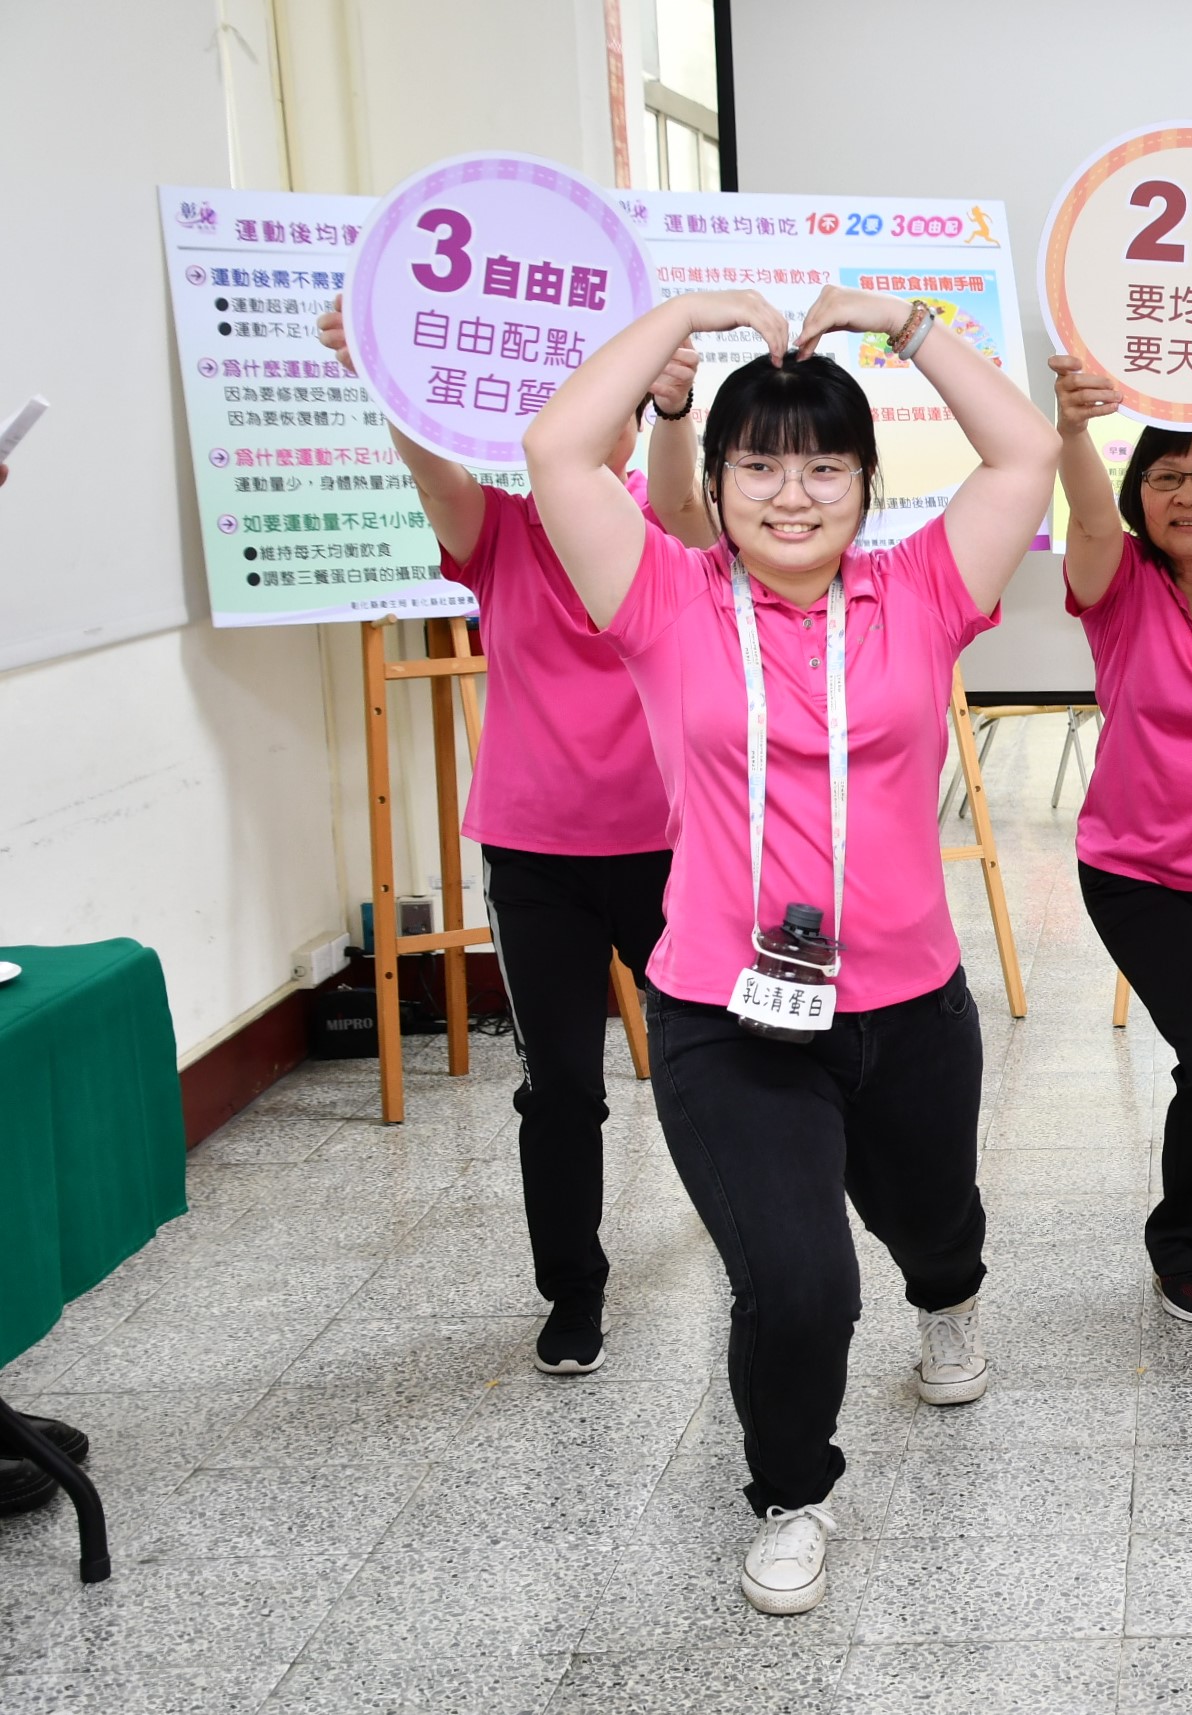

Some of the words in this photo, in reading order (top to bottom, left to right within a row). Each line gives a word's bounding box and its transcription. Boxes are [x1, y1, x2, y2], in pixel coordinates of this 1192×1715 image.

[664, 214, 798, 236] 運動後均衡吃
[1125, 179, 1188, 264] 2
[859, 275, 984, 292] 每日飲食指南手冊
[413, 309, 585, 369] 自由配點
[426, 365, 557, 416] 蛋白質
[742, 977, 823, 1017] 乳清蛋白
[326, 1018, 374, 1030] MIPRO
